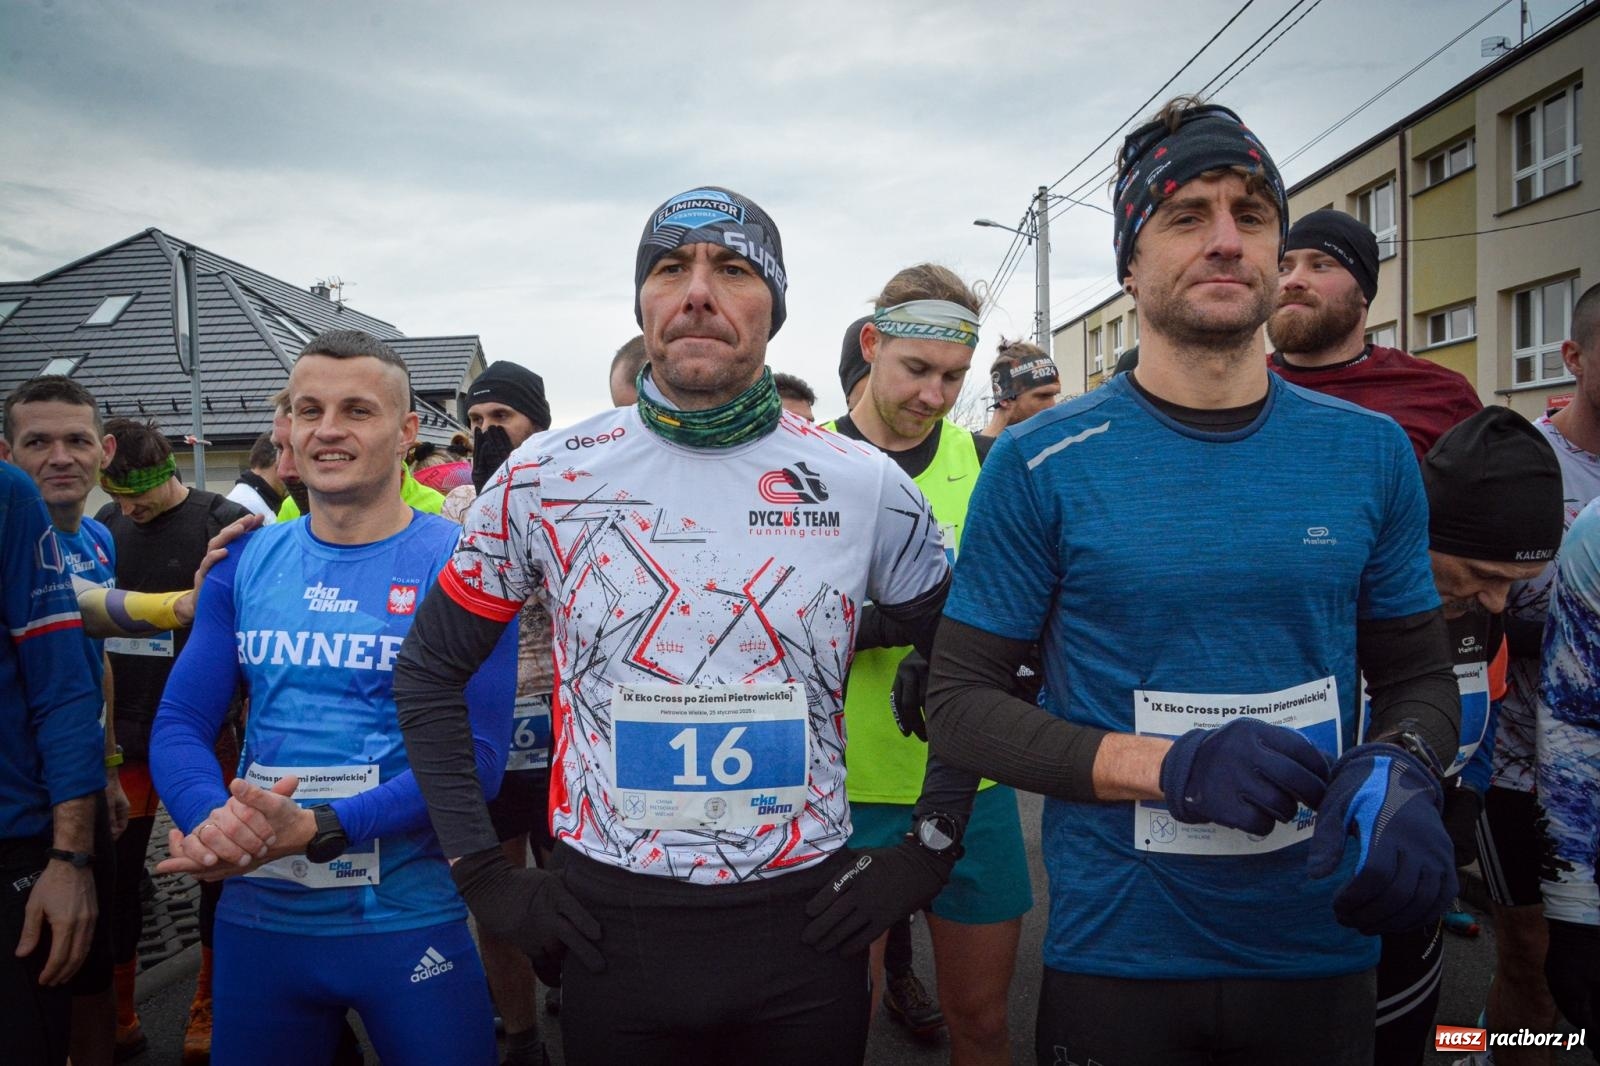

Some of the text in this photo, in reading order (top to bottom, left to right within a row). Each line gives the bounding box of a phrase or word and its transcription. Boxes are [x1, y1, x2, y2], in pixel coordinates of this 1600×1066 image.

[657, 200, 740, 224] ELIMINATOR
[1032, 367, 1057, 379] 2024
[565, 427, 625, 450] deep
[749, 507, 840, 527] DYCZUŚ TEAM
[749, 528, 840, 538] running club
[392, 576, 420, 584] POLAND
[623, 691, 793, 706] IX Eko Cross po Ziemi Pietrowickiej
[1151, 689, 1327, 717] IX Eko Cross po Ziemi Pietrowickiej
[668, 726, 753, 785] 16
[310, 773, 367, 783] Pietrowickiej
[411, 961, 453, 982] adidas
